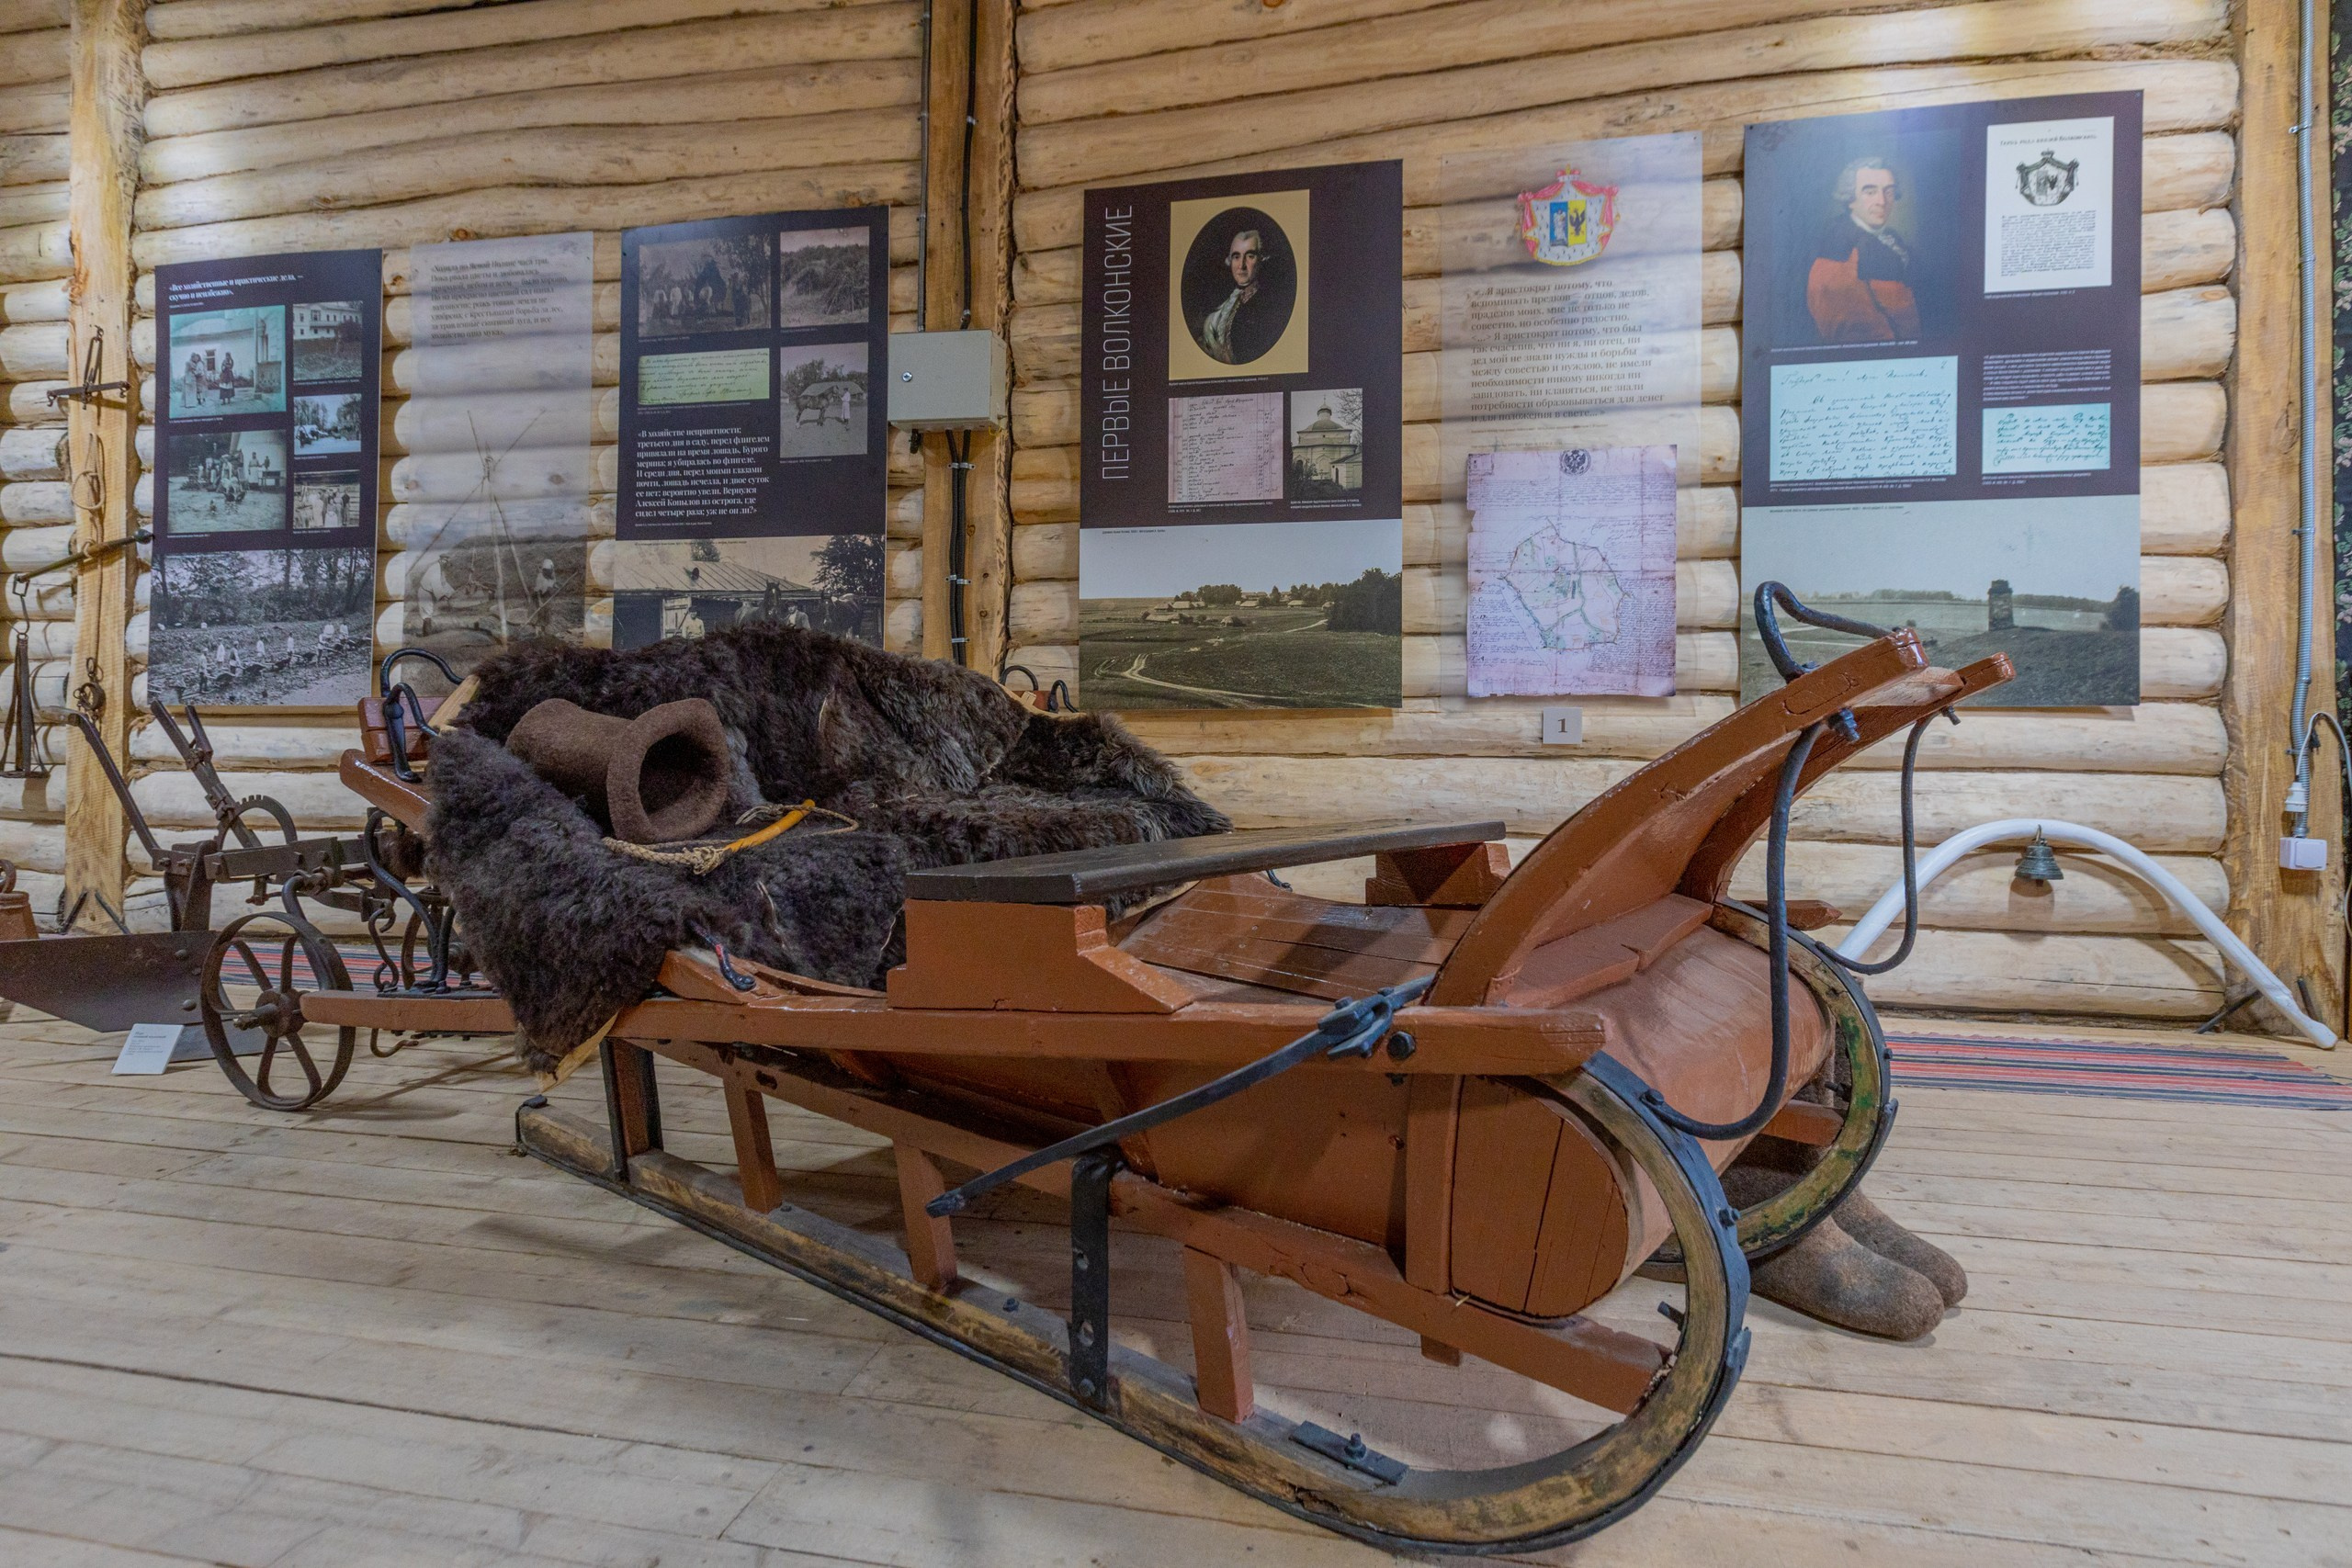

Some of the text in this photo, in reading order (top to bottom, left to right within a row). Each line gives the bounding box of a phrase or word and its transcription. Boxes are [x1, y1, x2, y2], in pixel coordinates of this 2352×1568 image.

[1496, 285, 1550, 296] аристократ
[1471, 298, 1528, 308] вспоминать
[1532, 294, 1570, 305] предков
[1471, 310, 1514, 321] прадедов
[1584, 303, 1615, 311] только
[1534, 317, 1578, 326] особенно
[1503, 331, 1557, 342] аристократ
[1623, 324, 1642, 333] был
[1102, 205, 1132, 479] ПЕРВЫЕ ВОЛКОНСКИЕ
[1471, 358, 1486, 367] дед
[1489, 355, 1507, 364] мой
[1525, 354, 1552, 362] знали
[1555, 352, 1588, 362] нужды
[1600, 347, 1636, 359] борьбы
[1471, 368, 1501, 378] между
[1505, 366, 1549, 375] совестью
[1471, 378, 1544, 388] необходимости
[1547, 376, 1582, 385] никому
[1586, 373, 1624, 381] никогда
[1471, 395, 1665, 412] потребности образовываться для денег
[648, 429, 685, 437] хозяйстве
[637, 440, 669, 449] третьего
[671, 439, 684, 447] дня
[710, 437, 731, 446] перед
[733, 435, 770, 446] флигелем
[637, 450, 675, 459] привязали
[687, 448, 709, 457] время
[742, 445, 768, 455] Бурого
[673, 458, 710, 468] убиралась
[644, 470, 664, 479] среди
[684, 469, 705, 478] перед
[747, 477, 769, 486] суток
[662, 490, 696, 498] вероятно
[723, 487, 756, 496] Вернулся
[635, 499, 666, 507] Алексей
[658, 510, 684, 518] четыре
[1557, 718, 1567, 733] 1
